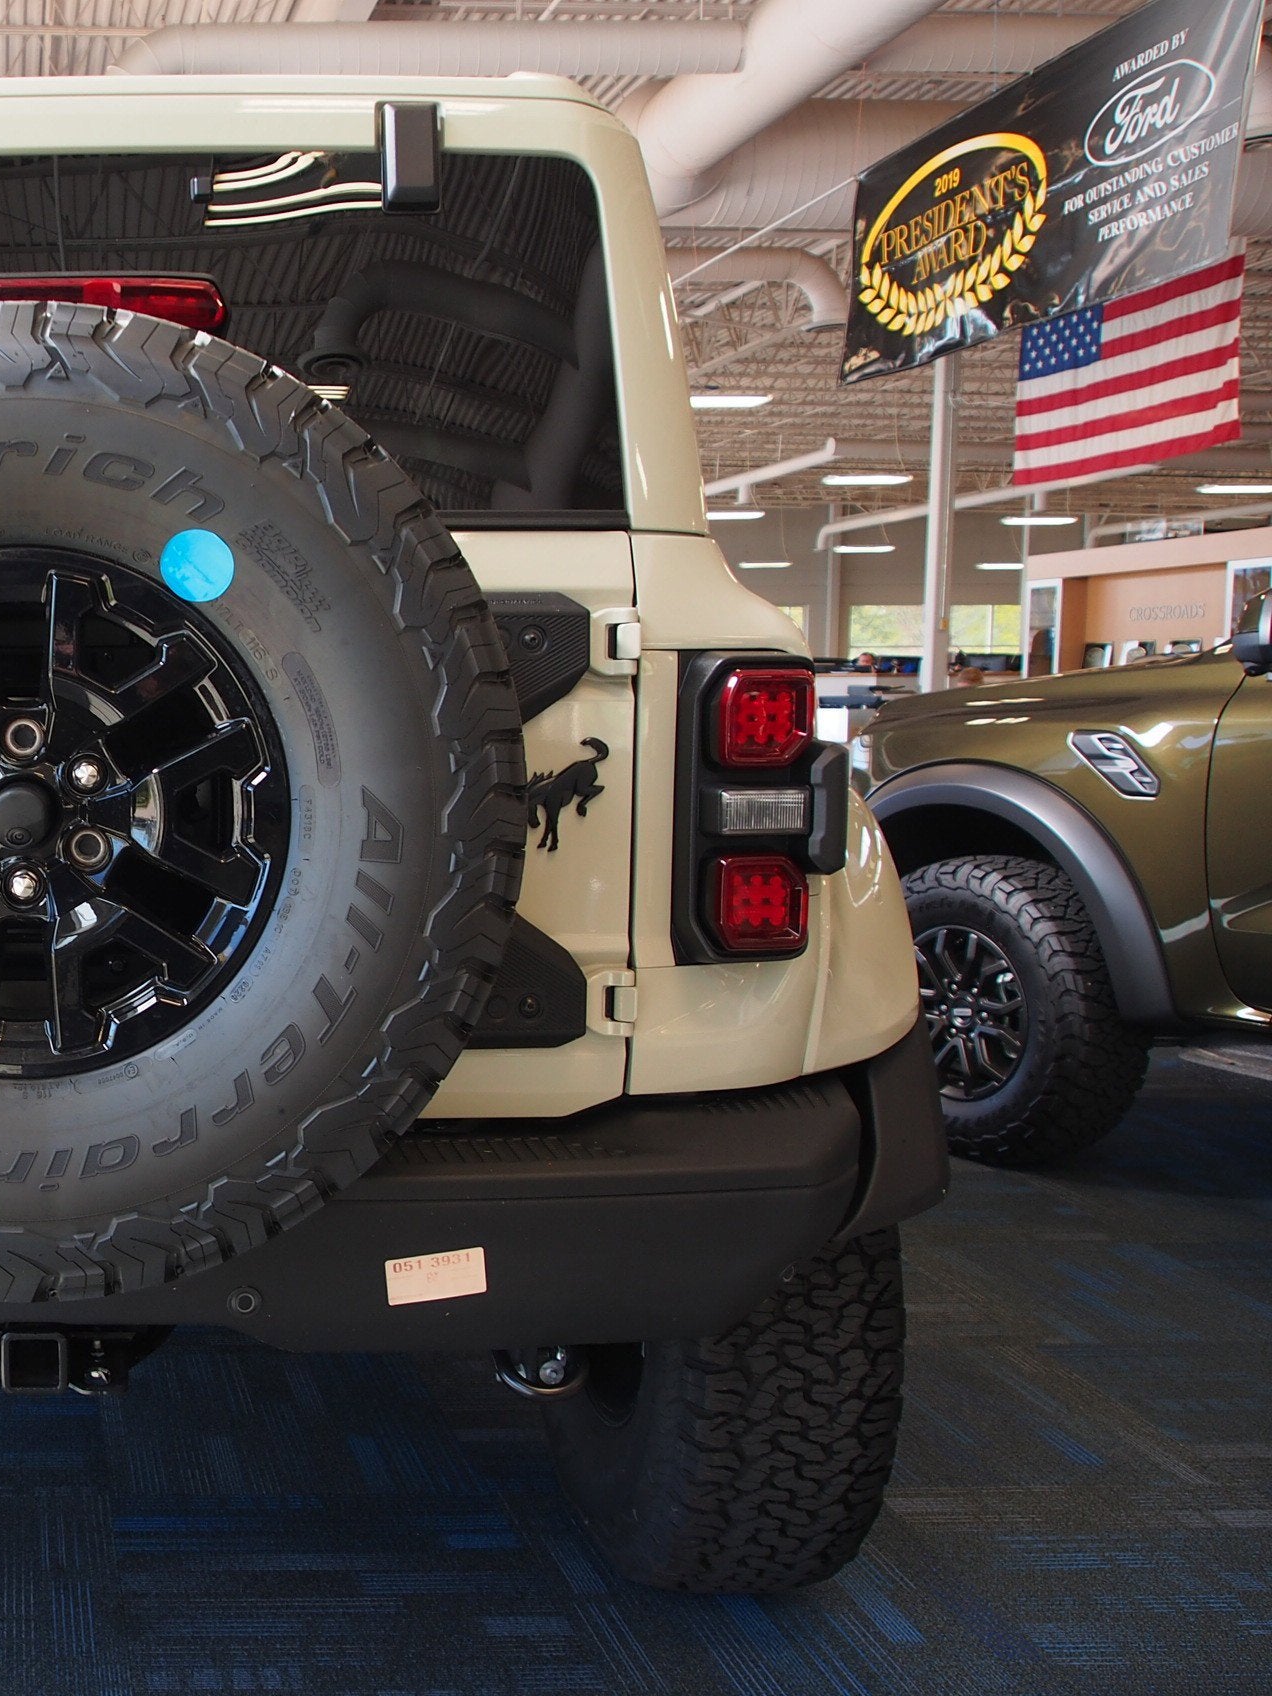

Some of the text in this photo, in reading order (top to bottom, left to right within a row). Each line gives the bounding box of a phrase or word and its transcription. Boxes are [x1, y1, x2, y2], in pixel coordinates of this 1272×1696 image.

[1112, 27, 1190, 83] AWARDED BY
[1104, 75, 1180, 155] Ford
[934, 168, 961, 197] 2019
[1063, 122, 1239, 215] FOR OUTSTANDING CUSTOMER
[1088, 161, 1210, 225] SERVICE AND SALES
[880, 161, 1030, 265] PRESIDENT'S
[1097, 191, 1194, 243] PERFORMANCE
[911, 220, 988, 284] AWARD
[1129, 602, 1207, 620] CROSSROADS
[392, 1252, 471, 1274] 051 3931
